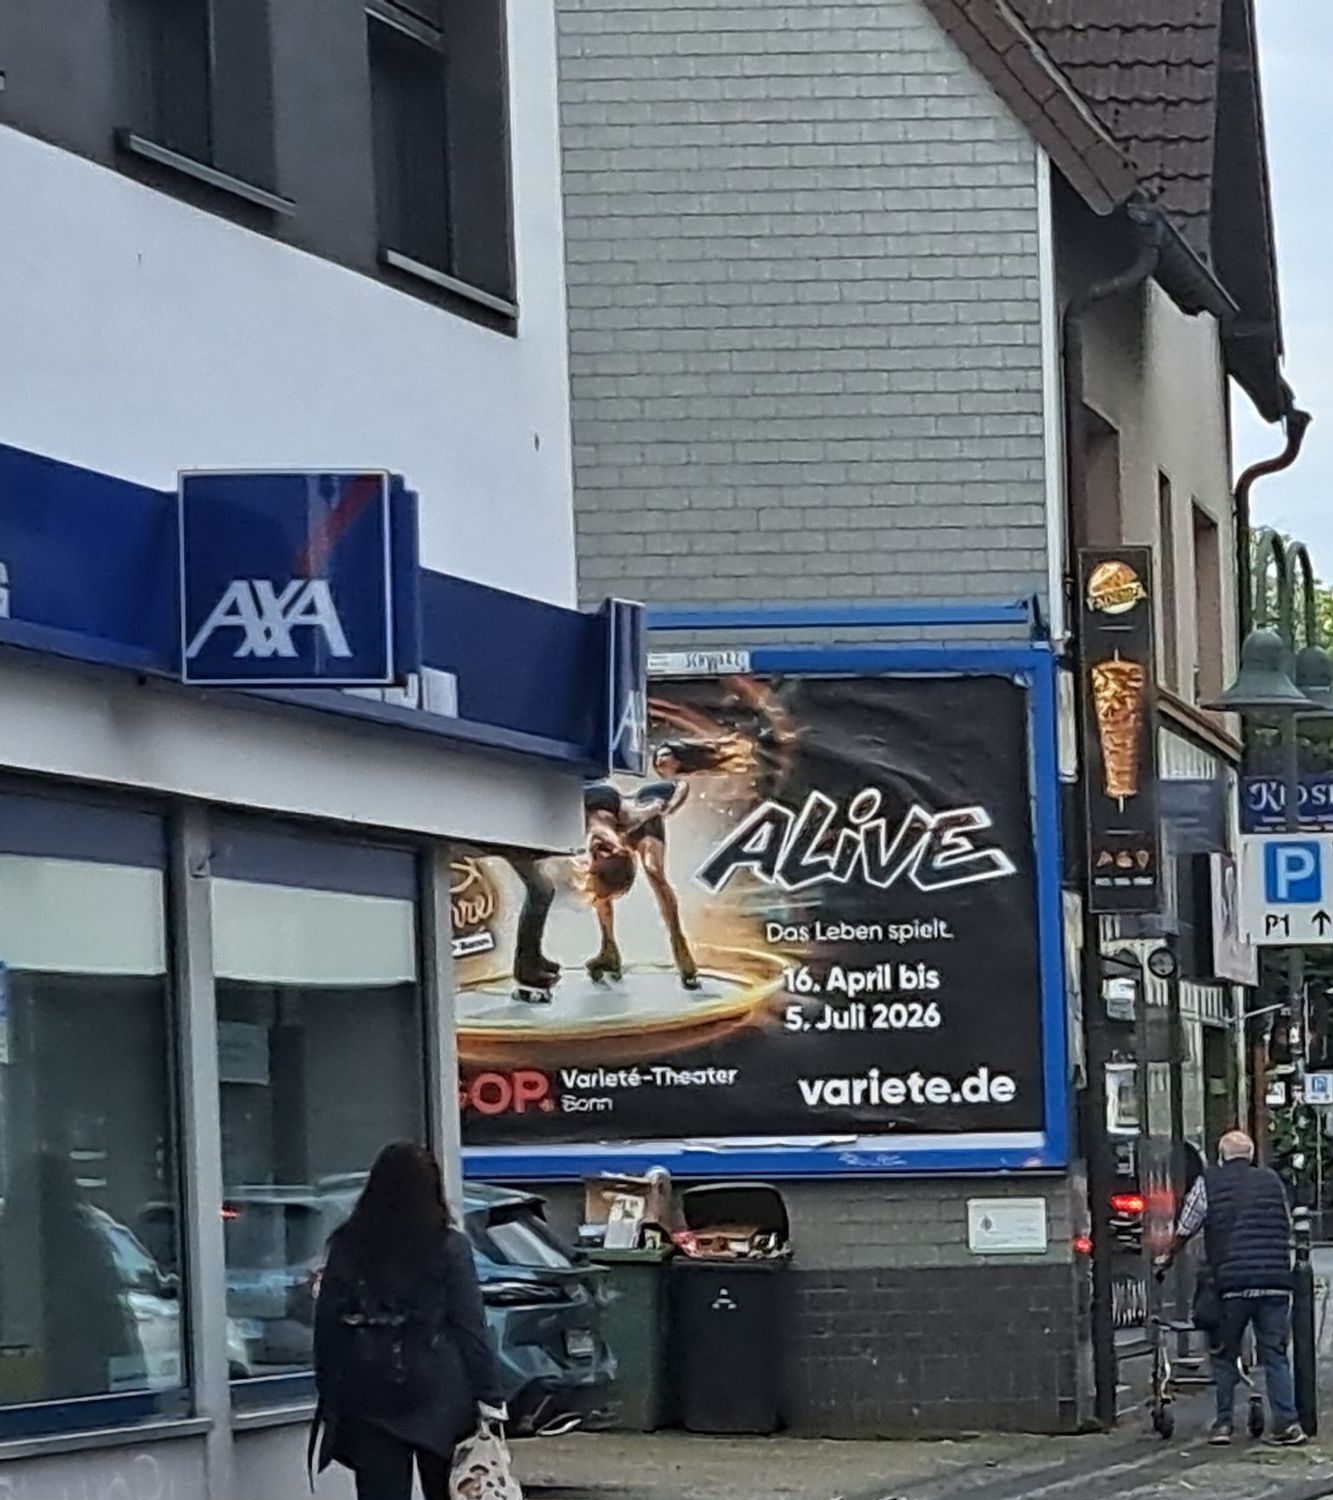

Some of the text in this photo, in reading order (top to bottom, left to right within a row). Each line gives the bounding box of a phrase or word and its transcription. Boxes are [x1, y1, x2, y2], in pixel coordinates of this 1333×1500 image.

[187, 580, 353, 658] AXA
[1276, 847, 1315, 899] P
[766, 921, 809, 943] Das
[815, 920, 883, 942] Leben
[1266, 914, 1290, 937] P1
[783, 962, 940, 997] 16. April bis
[784, 1001, 942, 1032] 5. Juli 2026
[460, 1069, 554, 1115] OP.
[560, 1066, 739, 1089] Varieté-Theater
[798, 1067, 1017, 1105] variete.de
[560, 1095, 613, 1113] Bonn
